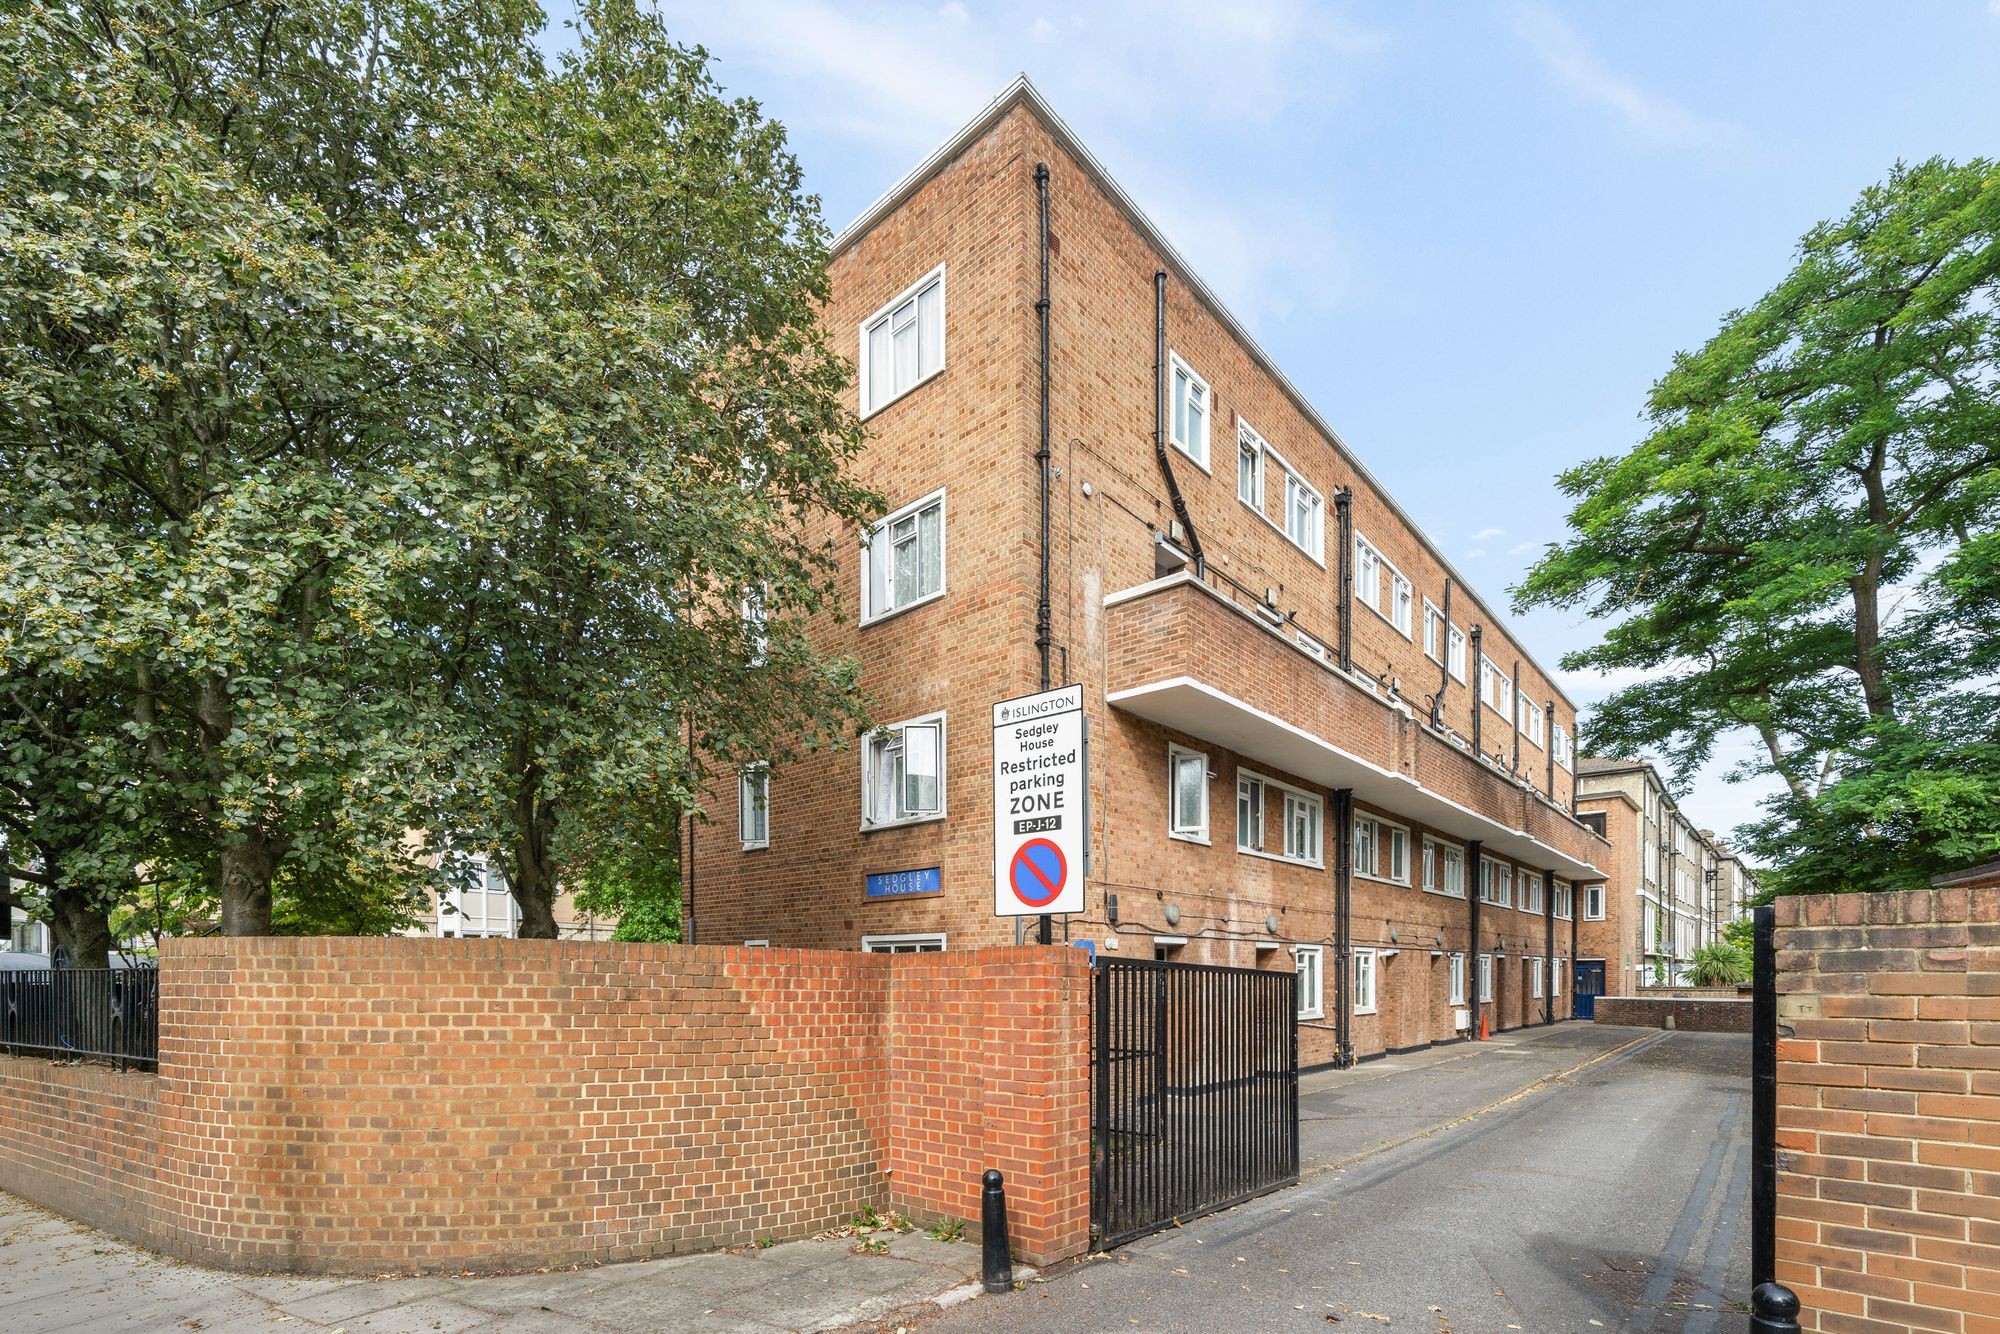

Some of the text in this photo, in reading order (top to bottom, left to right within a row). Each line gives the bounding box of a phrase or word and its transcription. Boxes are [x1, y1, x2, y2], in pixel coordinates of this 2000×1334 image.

[1012, 695, 1075, 719] ISLINGTON
[1015, 723, 1059, 739] Sedgley
[1020, 738, 1054, 752] House
[1000, 749, 1076, 776] Restricted
[1010, 773, 1065, 794] parking
[1010, 792, 1065, 815] ZONE
[1019, 817, 1057, 833] EP-J-12
[877, 870, 930, 885] SEDGLEY
[884, 881, 921, 894] HOUSE
